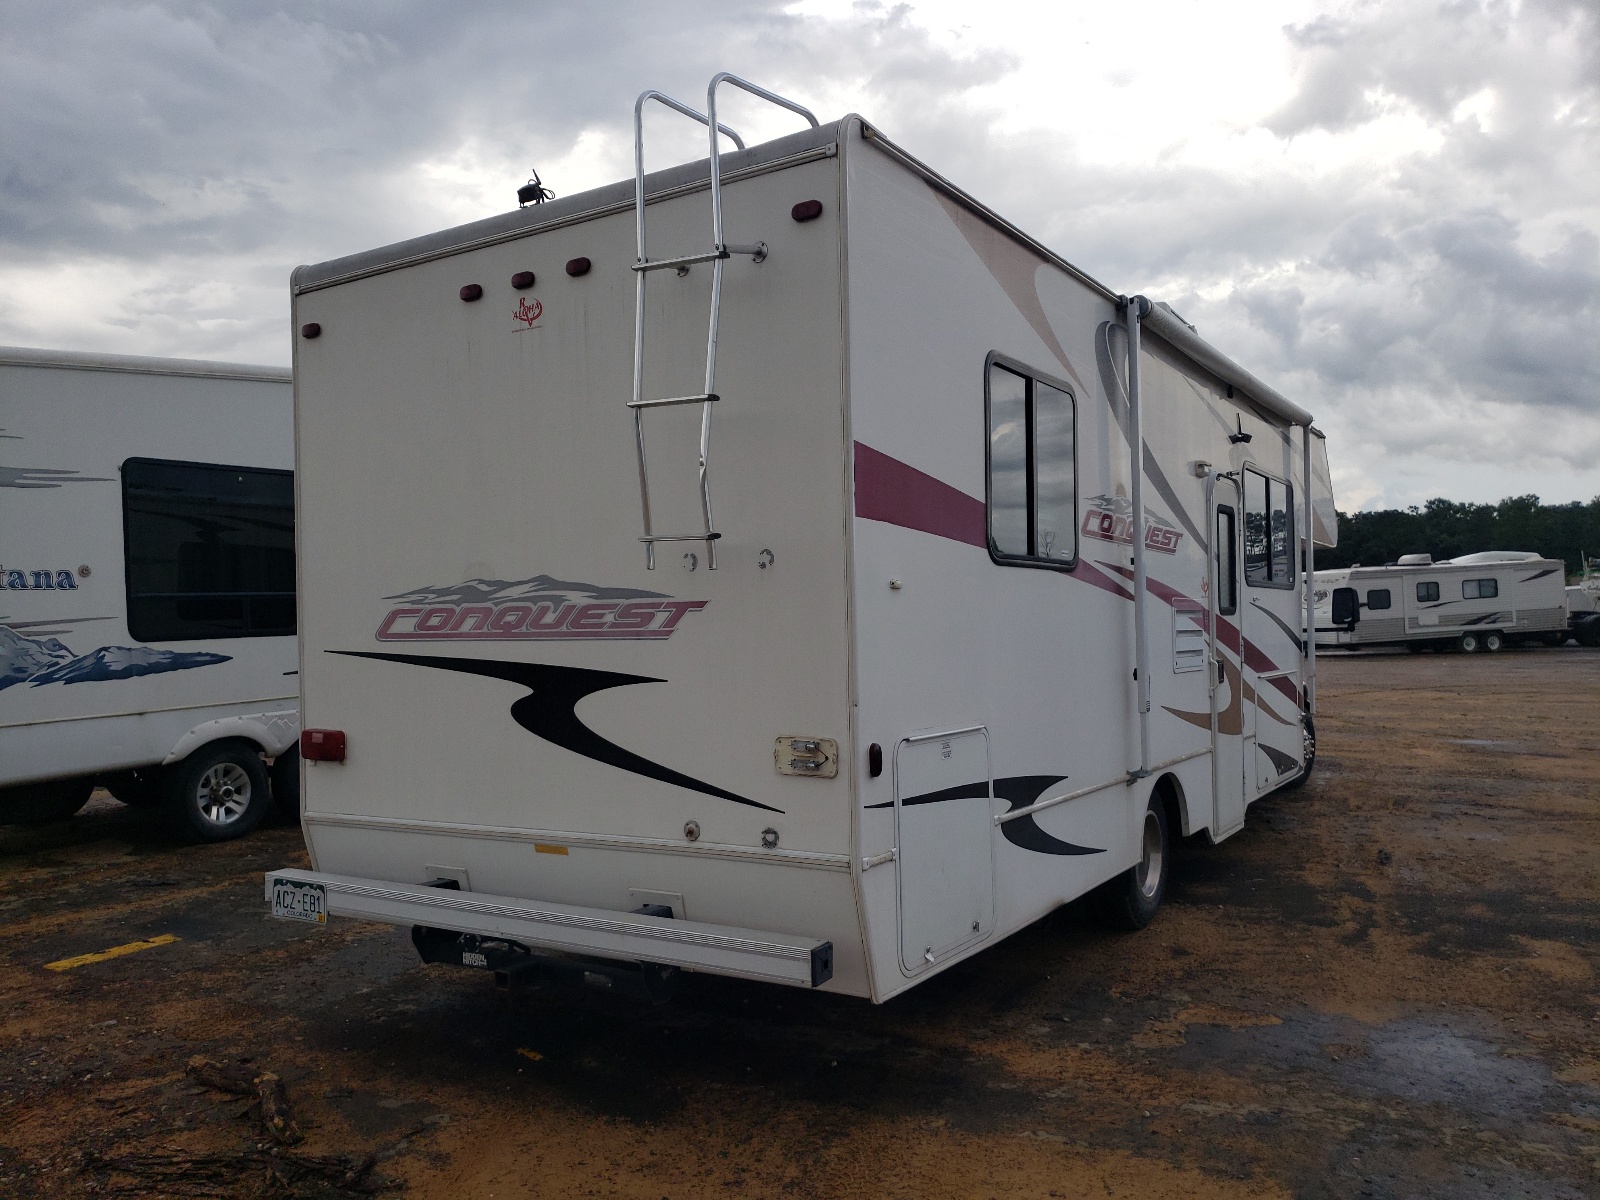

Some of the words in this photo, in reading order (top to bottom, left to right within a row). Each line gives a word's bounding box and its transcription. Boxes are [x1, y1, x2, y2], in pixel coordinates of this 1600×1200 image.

[375, 599, 712, 641] CONQUEST
[286, 909, 313, 919] COLORADO
[462, 952, 485, 961] HIDDEN
[462, 957, 482, 966] HITCH
